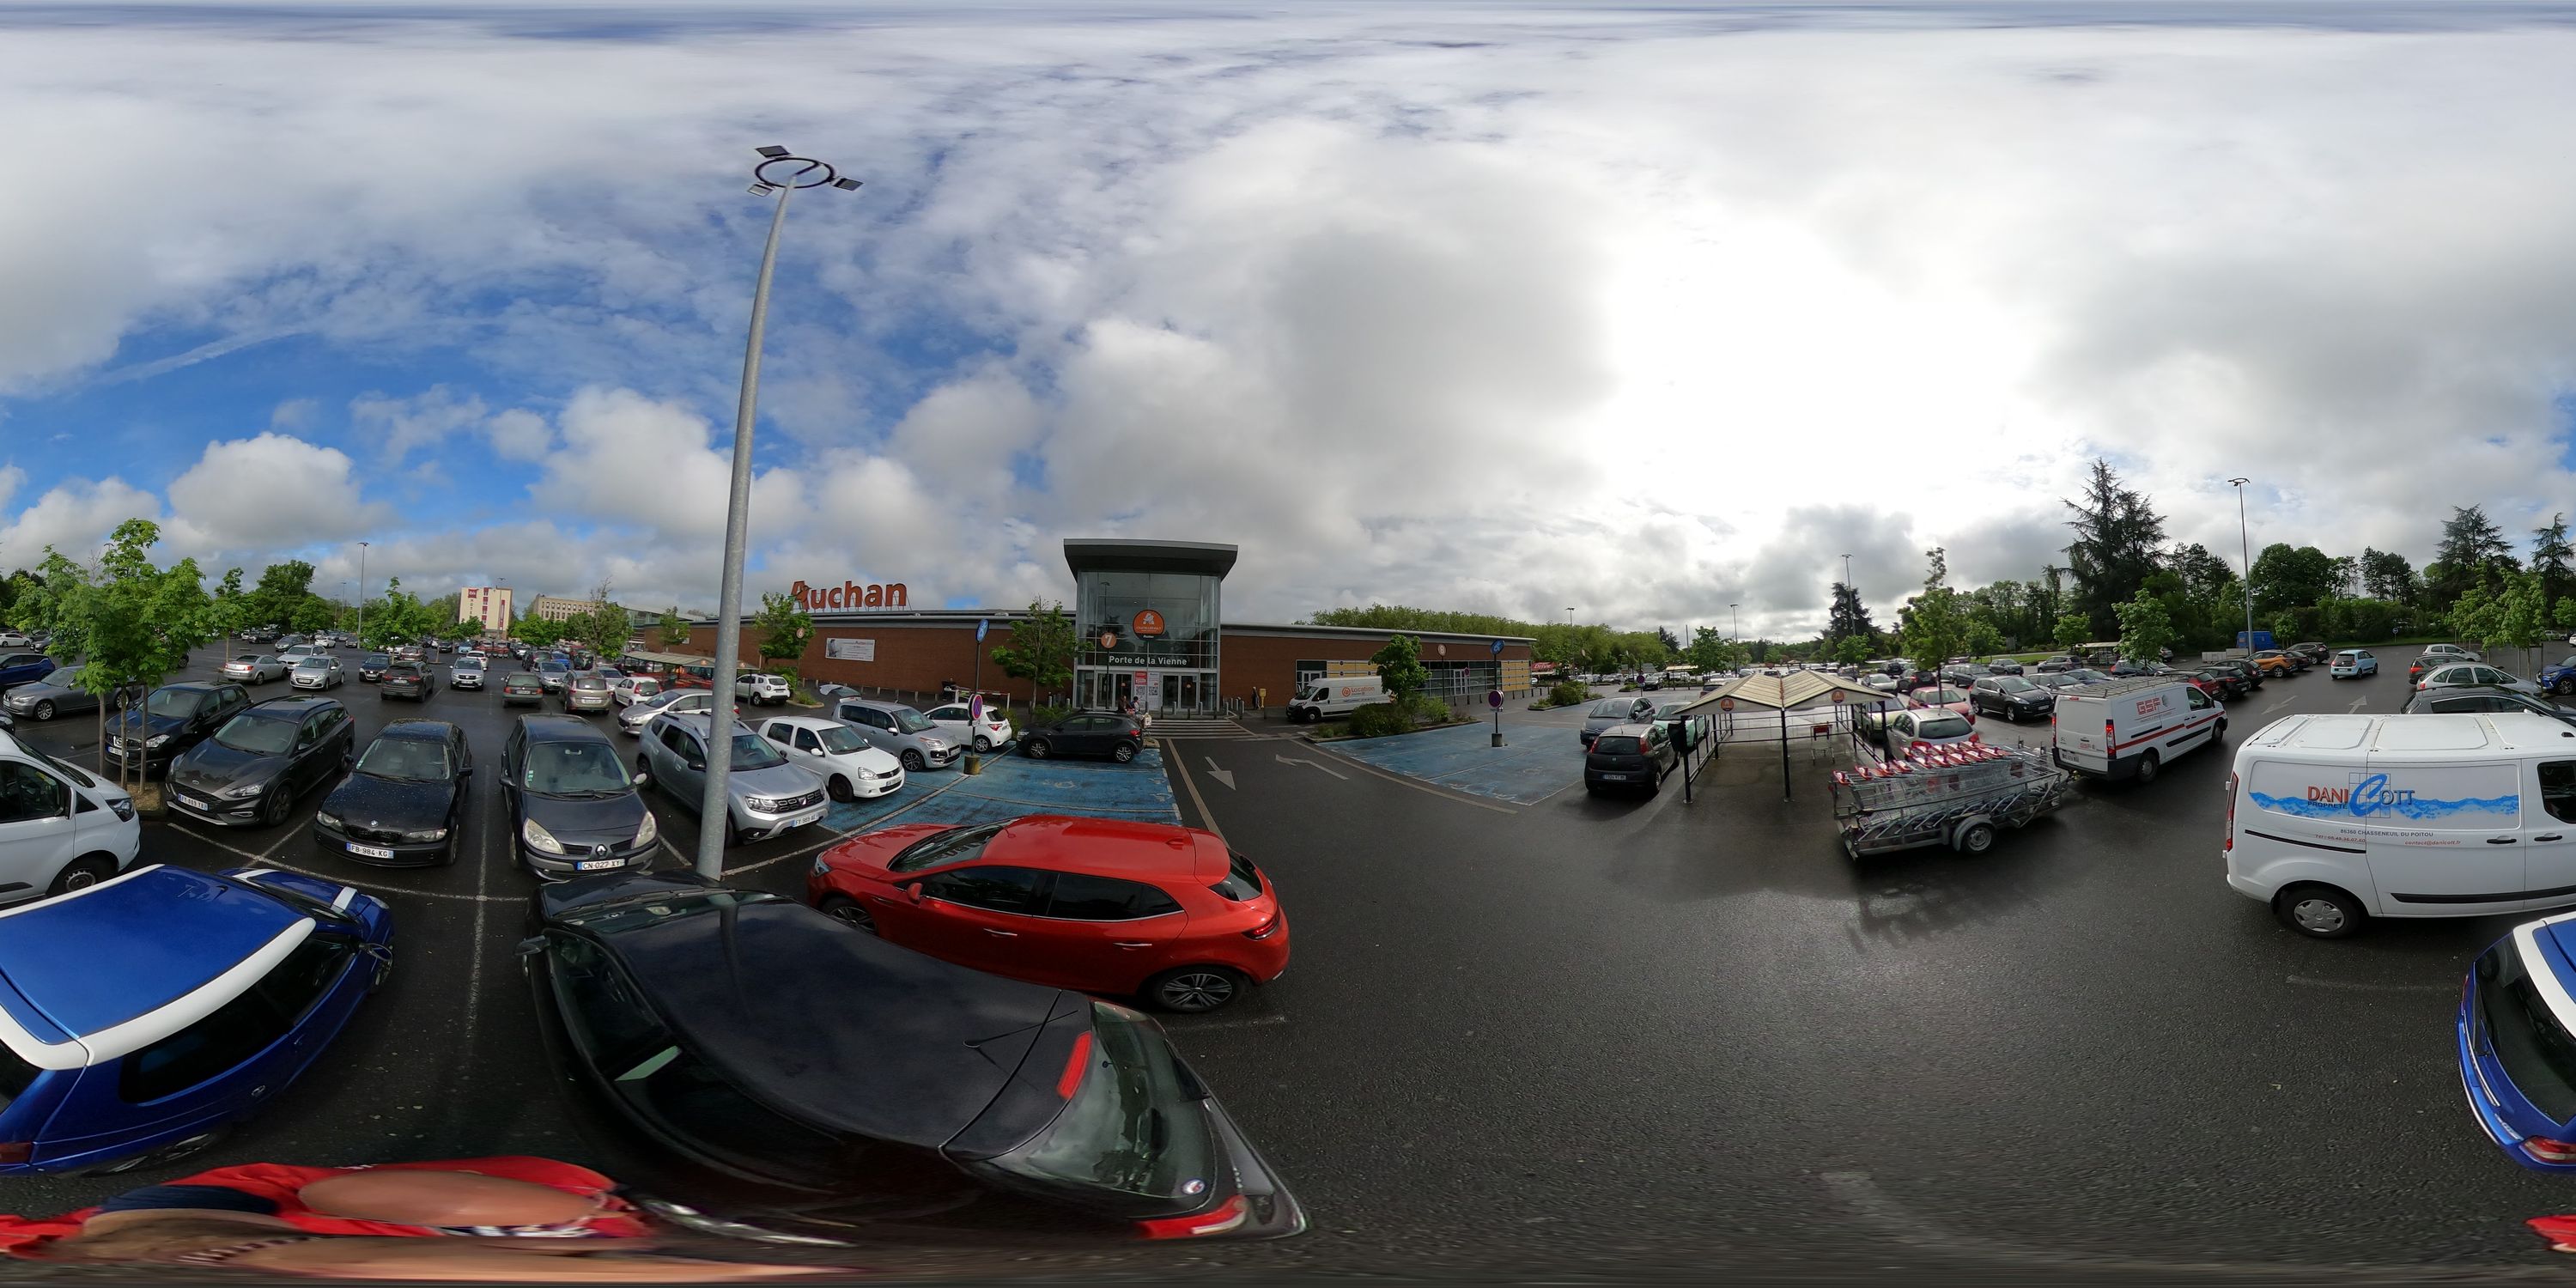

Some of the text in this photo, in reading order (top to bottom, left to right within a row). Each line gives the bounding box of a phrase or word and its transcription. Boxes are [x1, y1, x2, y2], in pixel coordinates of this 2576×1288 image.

[791, 580, 907, 611] Auchan
[1105, 635, 1112, 647] 7
[1109, 655, 1133, 664] Porte
[1134, 656, 1145, 665] de
[1157, 657, 1188, 665] Vienne
